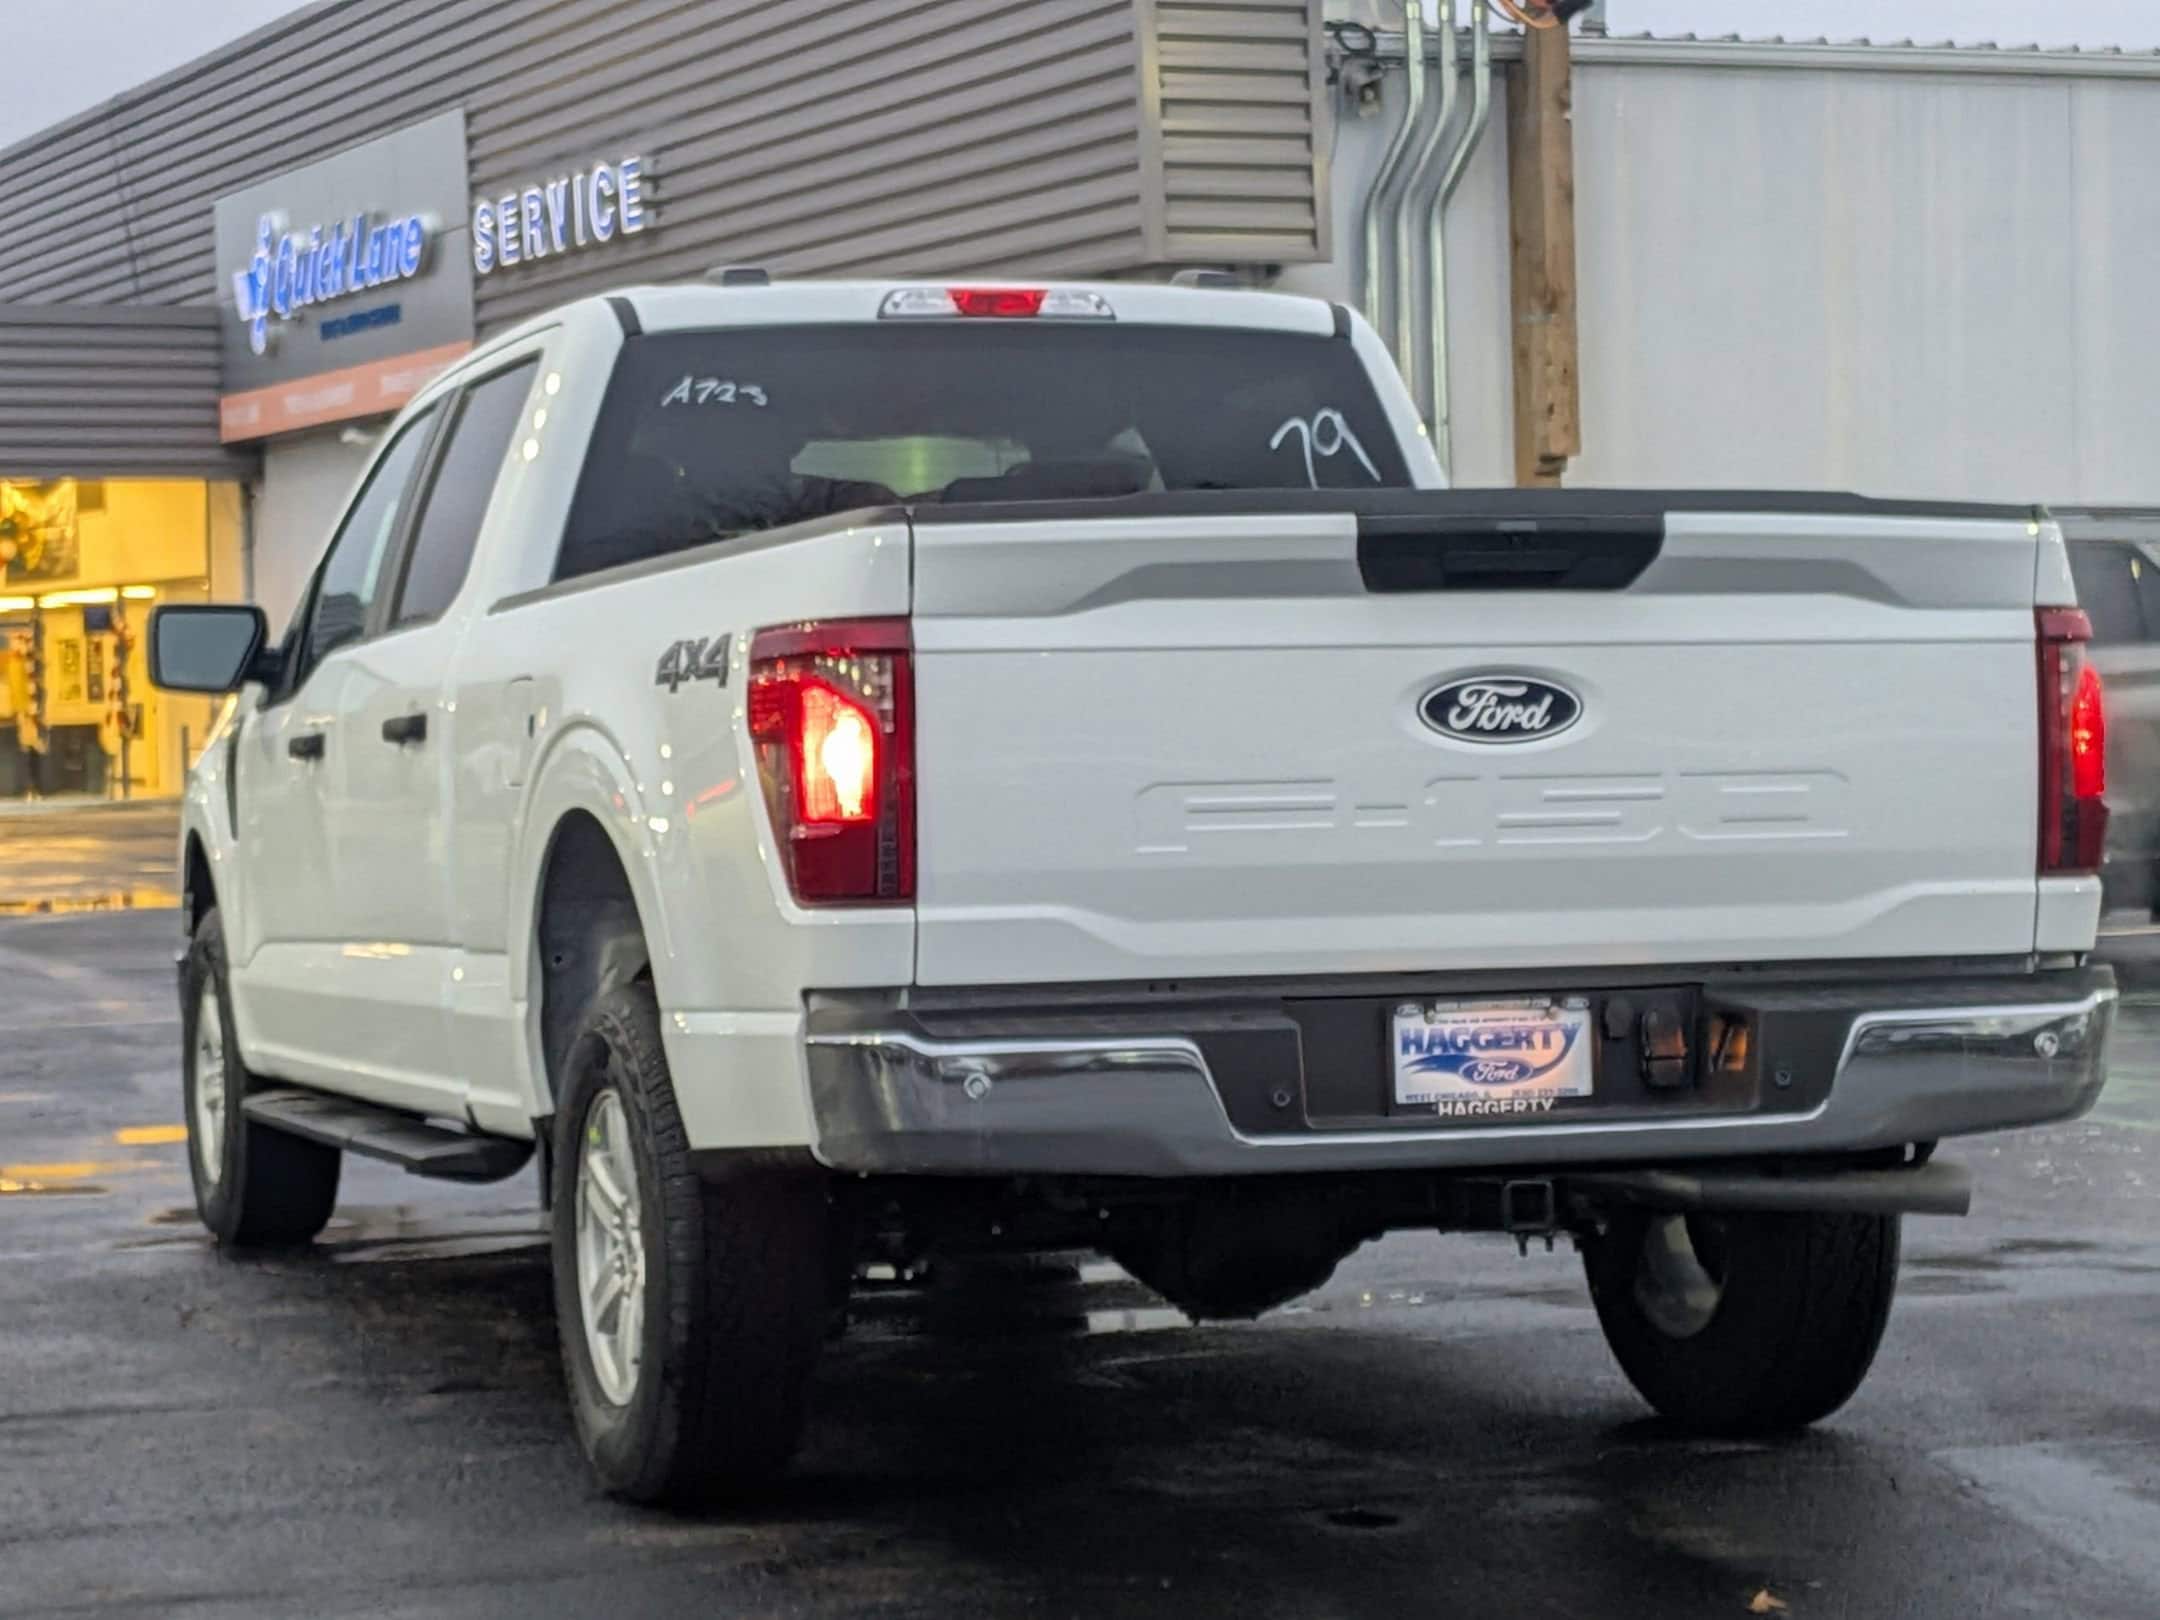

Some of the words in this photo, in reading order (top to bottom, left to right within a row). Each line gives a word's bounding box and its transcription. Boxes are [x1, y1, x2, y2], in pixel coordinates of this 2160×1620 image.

[473, 155, 645, 275] SERVICE
[273, 221, 350, 320] Quick
[348, 213, 423, 293] Lane
[1447, 684, 1554, 731] Ford
[1401, 1023, 1583, 1058] HAGGERTY
[1473, 1061, 1520, 1081] Ford
[1438, 1098, 1556, 1116] HAGGERTY
